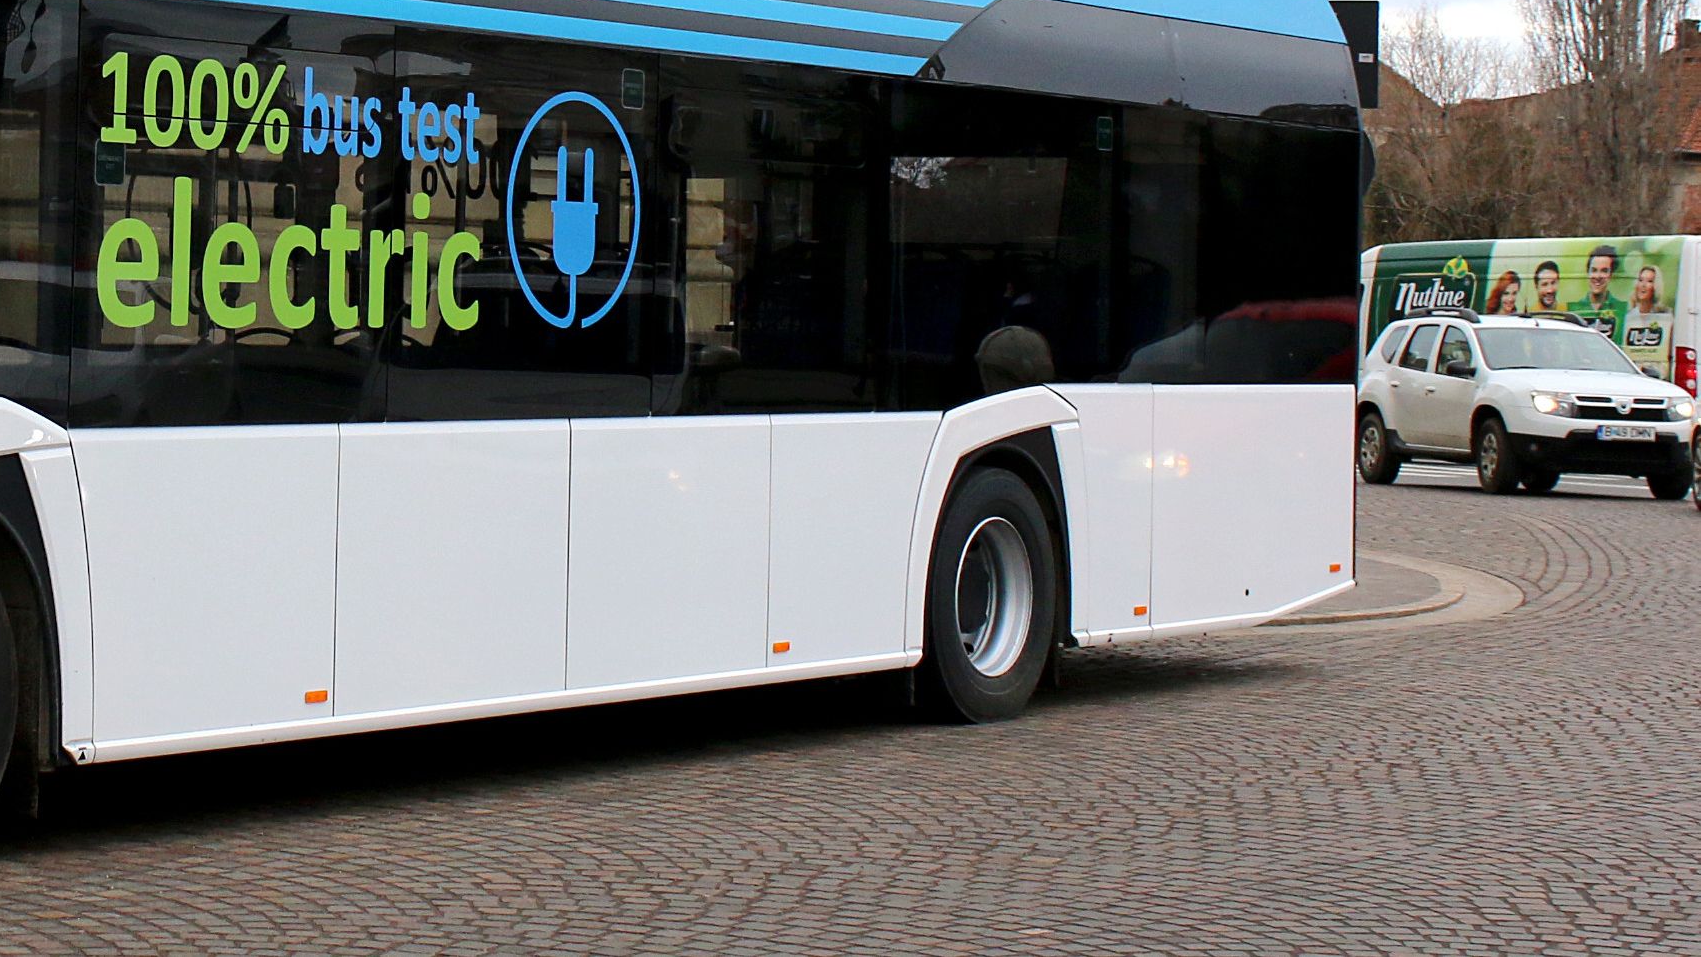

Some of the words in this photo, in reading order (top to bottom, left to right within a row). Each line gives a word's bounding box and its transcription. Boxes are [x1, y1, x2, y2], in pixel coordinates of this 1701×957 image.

[100, 51, 290, 154] 100%
[302, 66, 381, 158] bus
[400, 86, 480, 164] test
[97, 176, 481, 331] electric
[1395, 277, 1465, 316] Nutline
